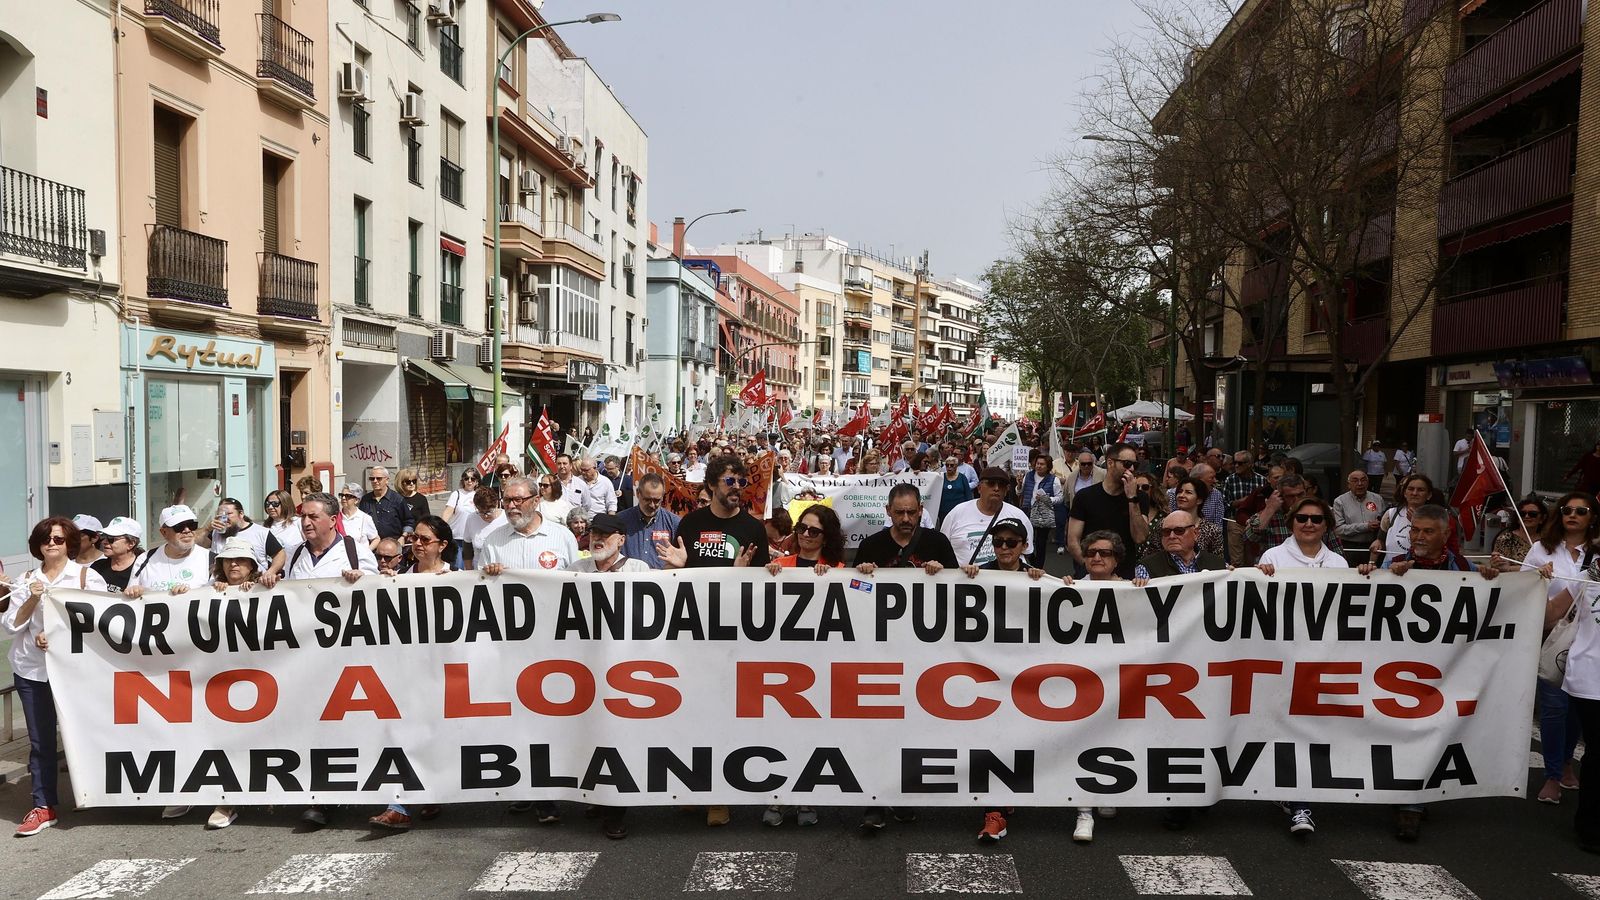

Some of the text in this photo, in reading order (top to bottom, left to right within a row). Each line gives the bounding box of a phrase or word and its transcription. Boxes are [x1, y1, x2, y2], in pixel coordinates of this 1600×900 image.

[146, 335, 261, 370] Rytual
[65, 371, 72, 386] 3
[693, 541, 725, 551] SOUTH
[699, 548, 725, 559] FACE
[65, 581, 1516, 655] POR UNA SANIDAD ANDALUZA PUBLICA Y UNIVERSAL.
[113, 660, 1478, 724] NO A LOS RECORTES.
[105, 742, 1478, 794] MAREA BLANCA EN SEVILLA
